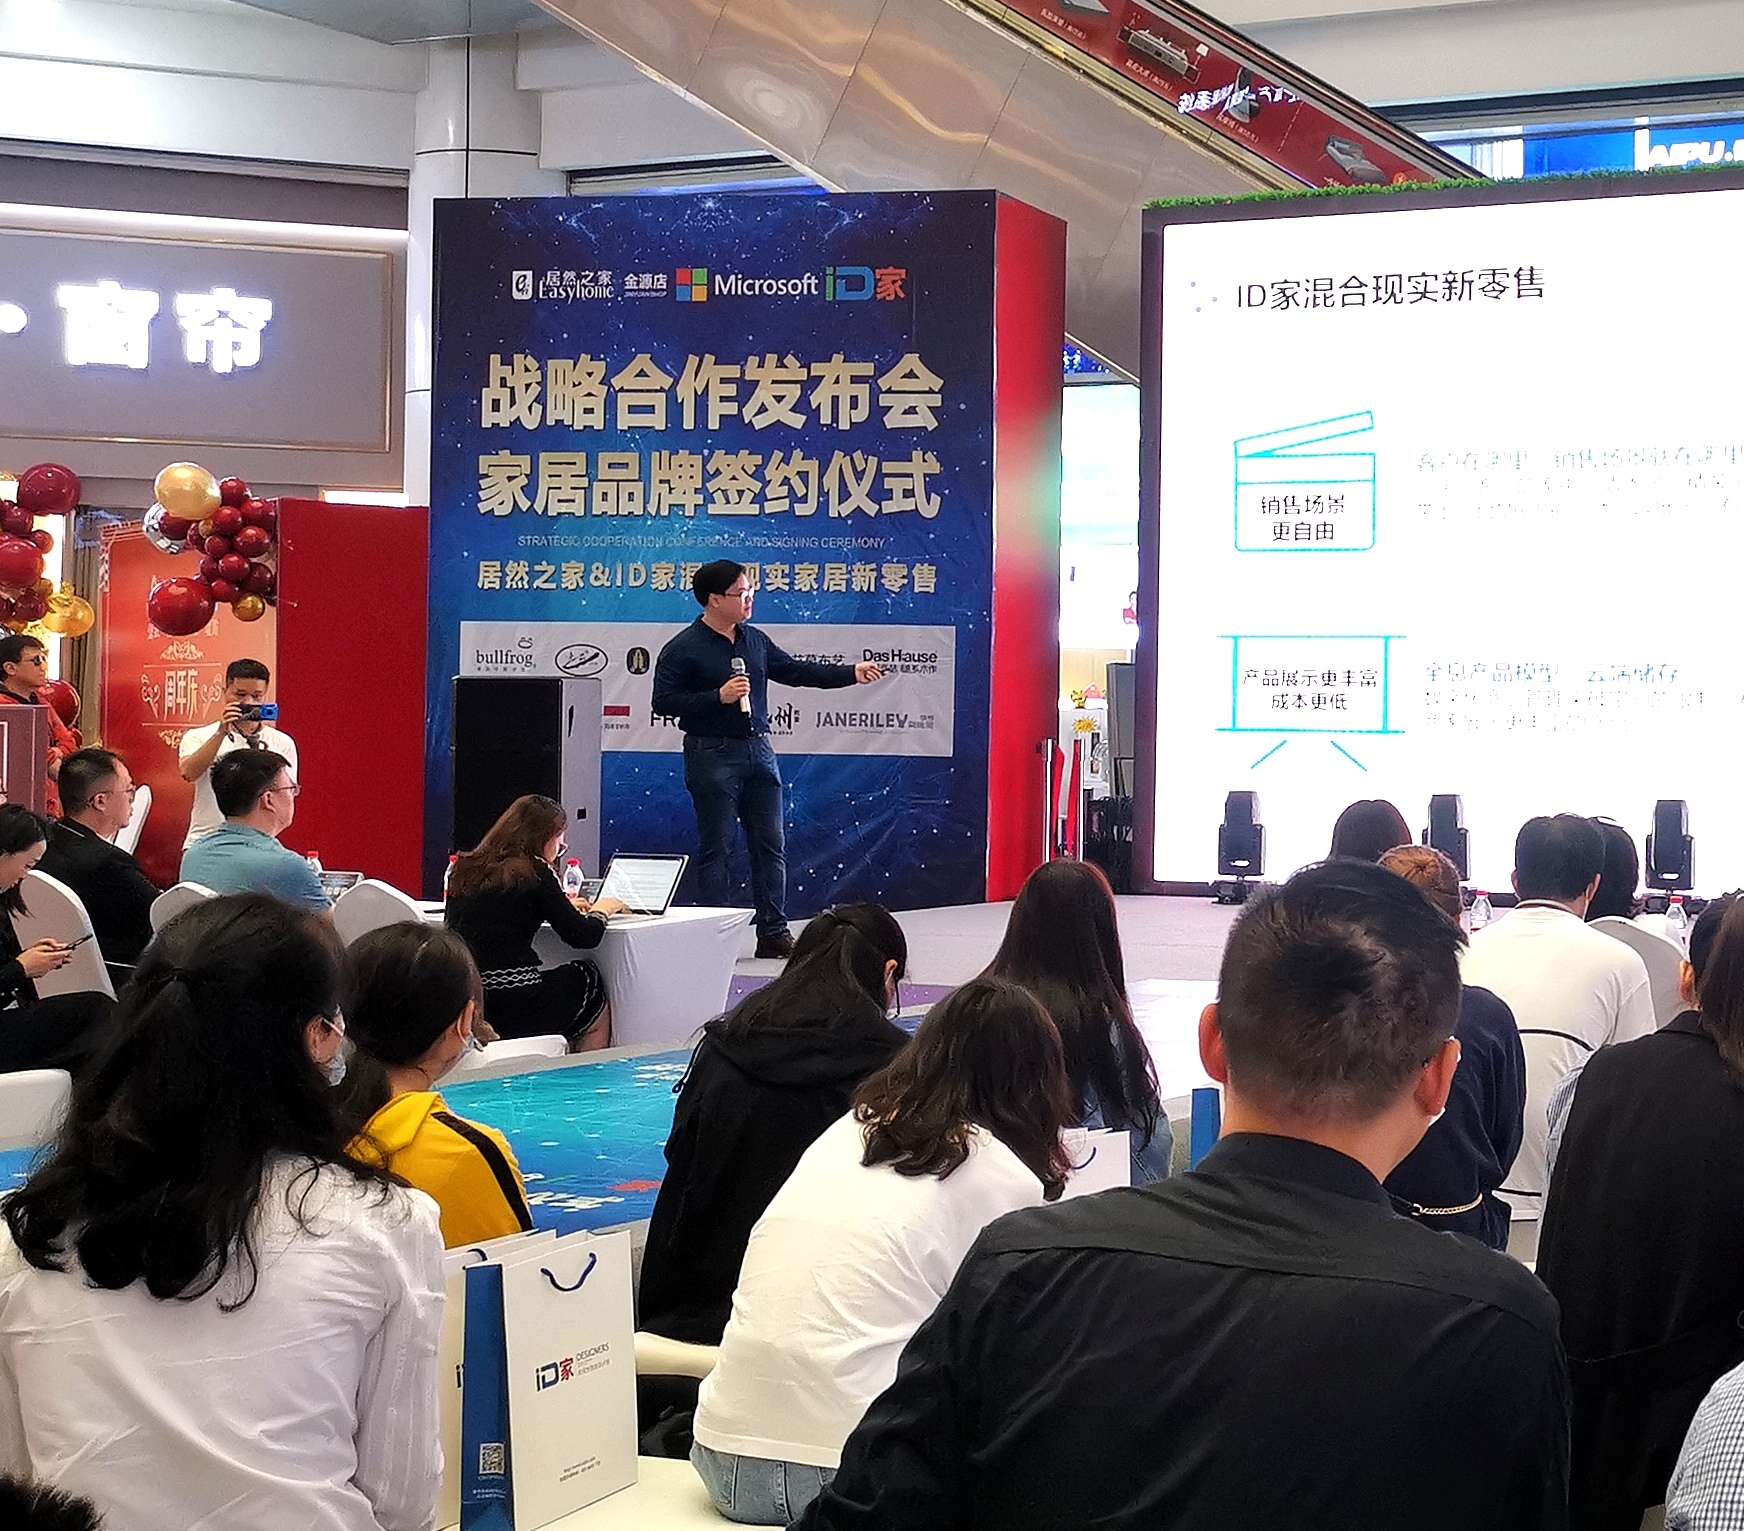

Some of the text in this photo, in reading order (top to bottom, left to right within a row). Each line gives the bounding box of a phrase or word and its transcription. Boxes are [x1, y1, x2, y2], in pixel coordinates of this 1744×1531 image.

[624, 273, 668, 290] 金源店
[714, 272, 819, 297] Microsoft
[1237, 266, 1545, 310] ID家混合现实新零售
[480, 353, 944, 431] 战略合作发布会
[477, 449, 941, 518] 家居品牌签约仪式
[1261, 495, 1345, 515] 销售场景
[1272, 521, 1334, 541] 更自由
[477, 559, 937, 593] 居然之家&ID家混现实家居新零售
[475, 649, 534, 668] bullfrog
[1243, 669, 1378, 688] 产品展示更丰富
[1271, 693, 1347, 711] 成本更低
[816, 711, 909, 729] JANERILEY
